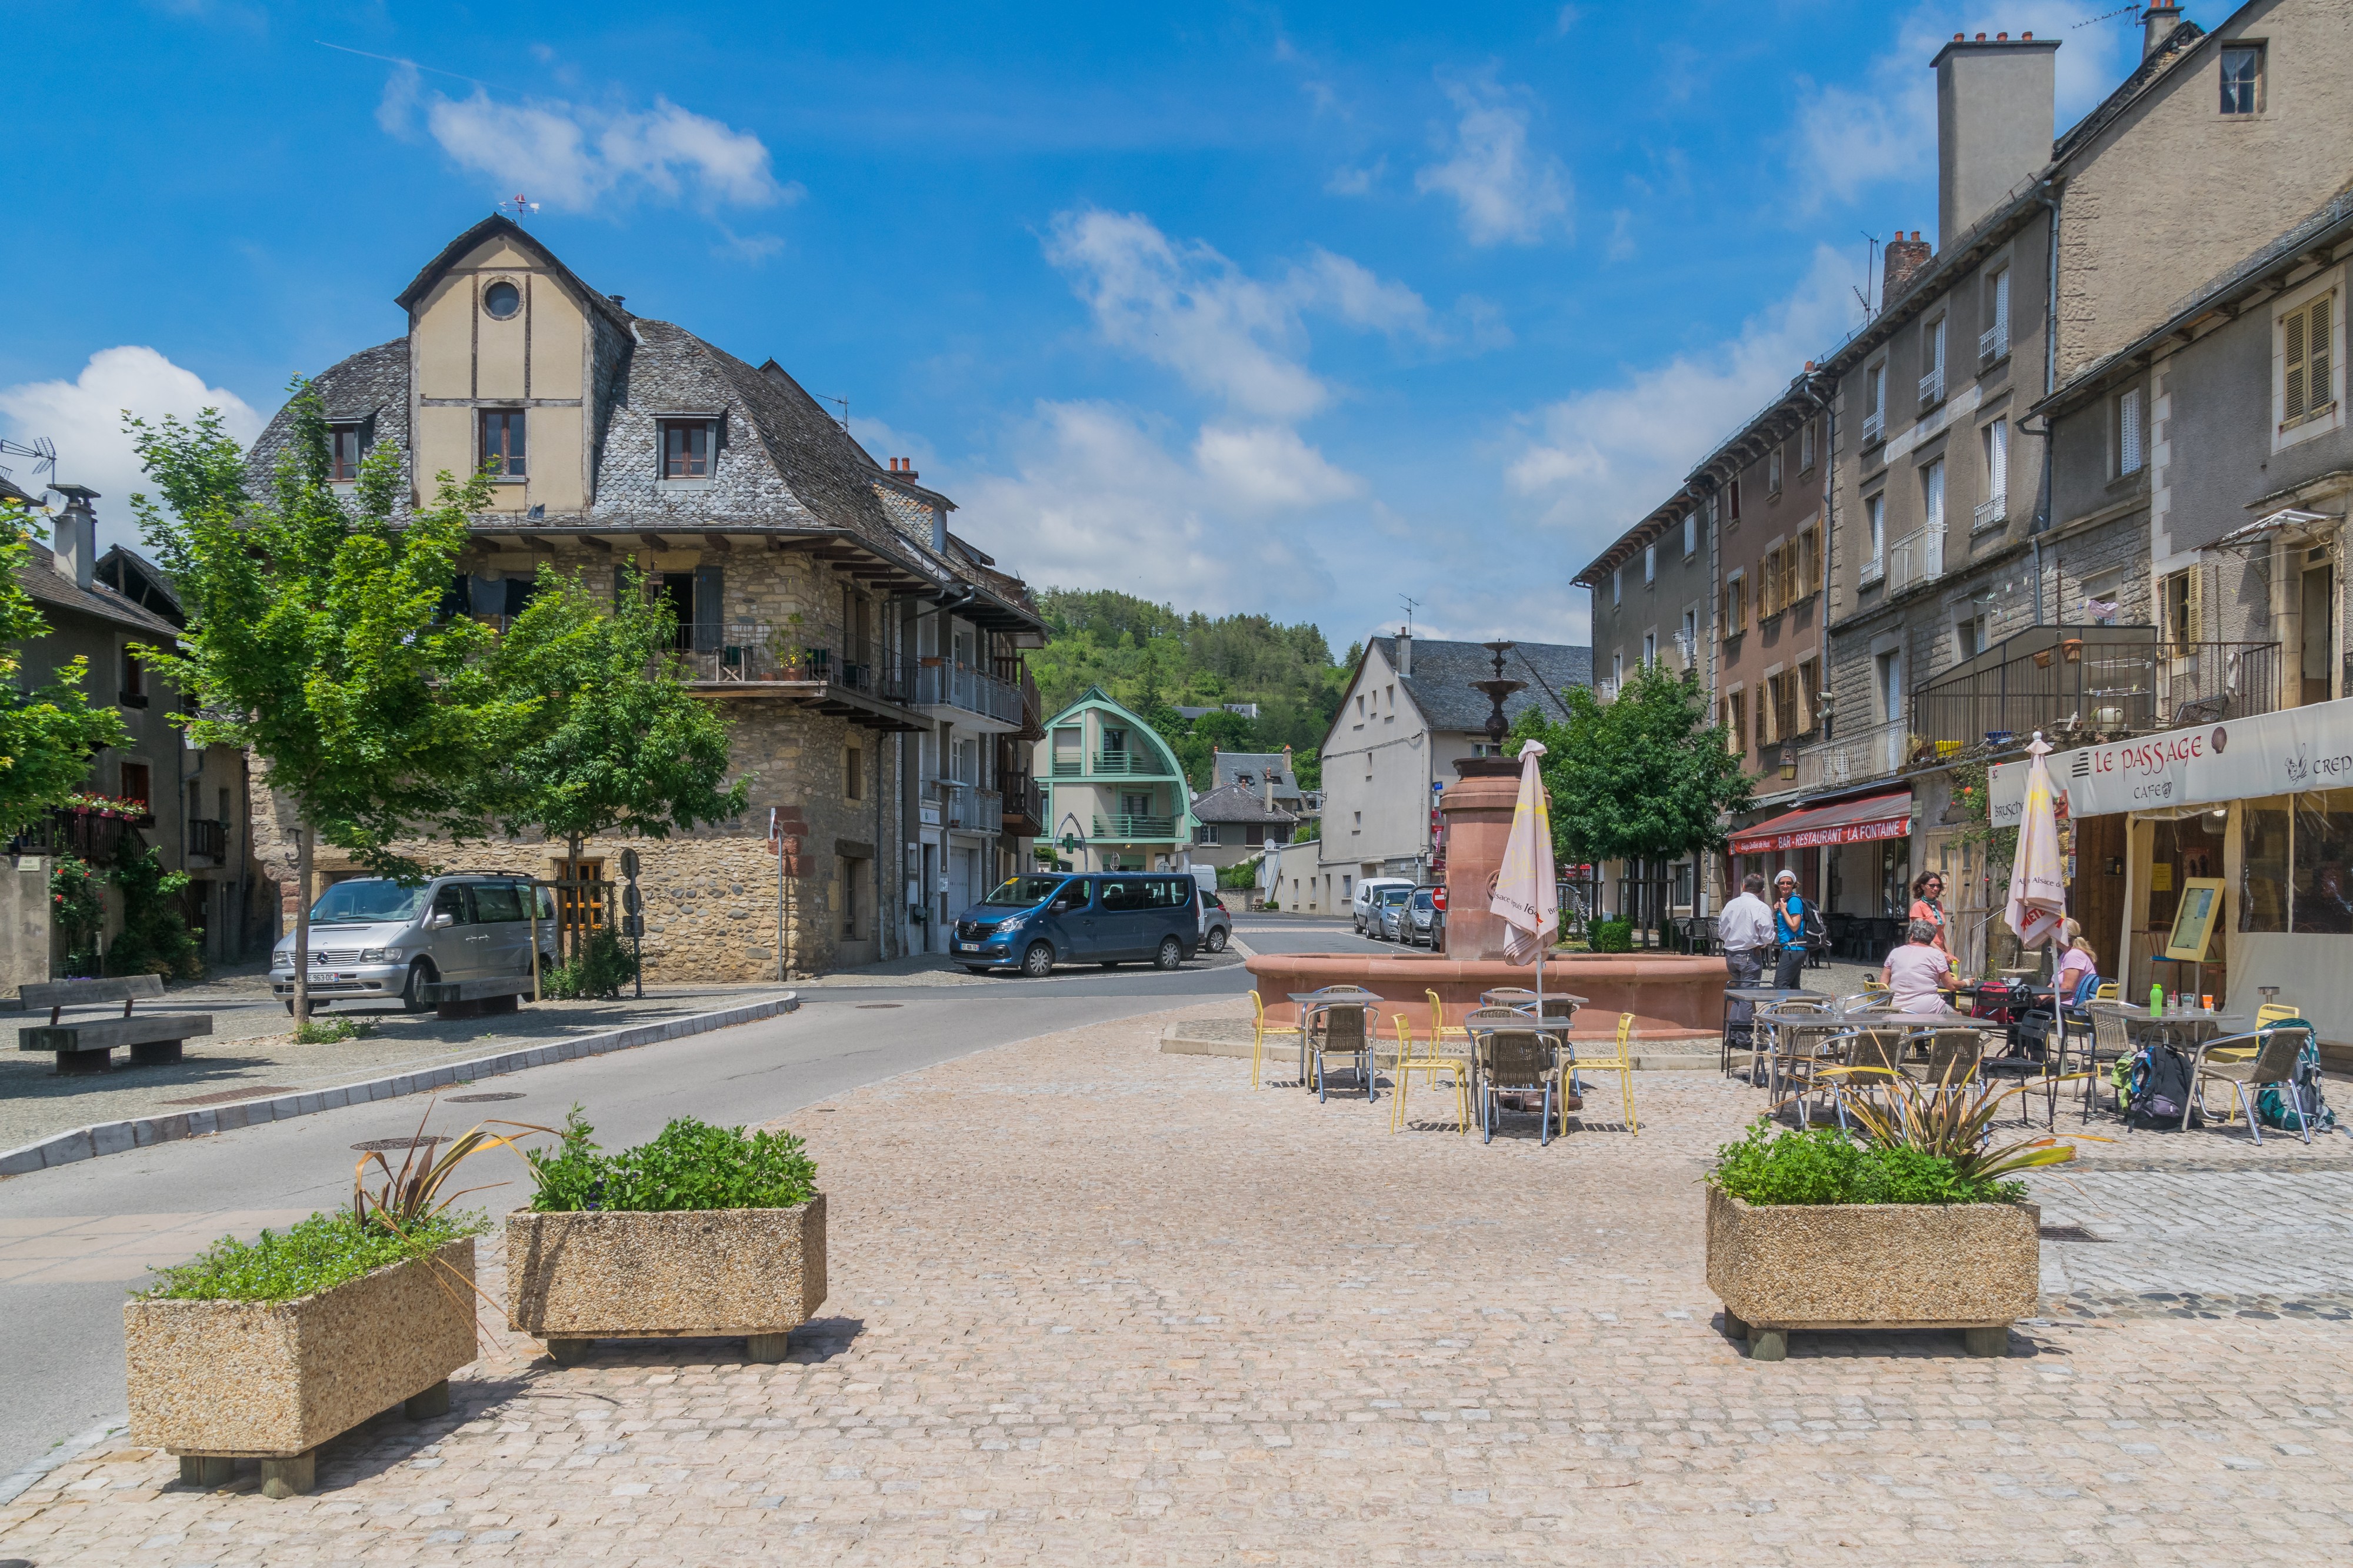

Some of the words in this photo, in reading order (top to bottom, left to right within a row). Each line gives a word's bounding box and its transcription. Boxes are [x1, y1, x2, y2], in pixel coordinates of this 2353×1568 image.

[2094, 750, 2114, 773] LE
[2121, 735, 2203, 782] PASSAGE
[2134, 783, 2161, 805] CAFE
[1778, 835, 1791, 848] BAR
[1796, 828, 1842, 846] RESTAURANT
[1848, 826, 1859, 841] LA
[1860, 820, 1900, 840] FONTAINE
[2032, 876, 2054, 886] Alsace
